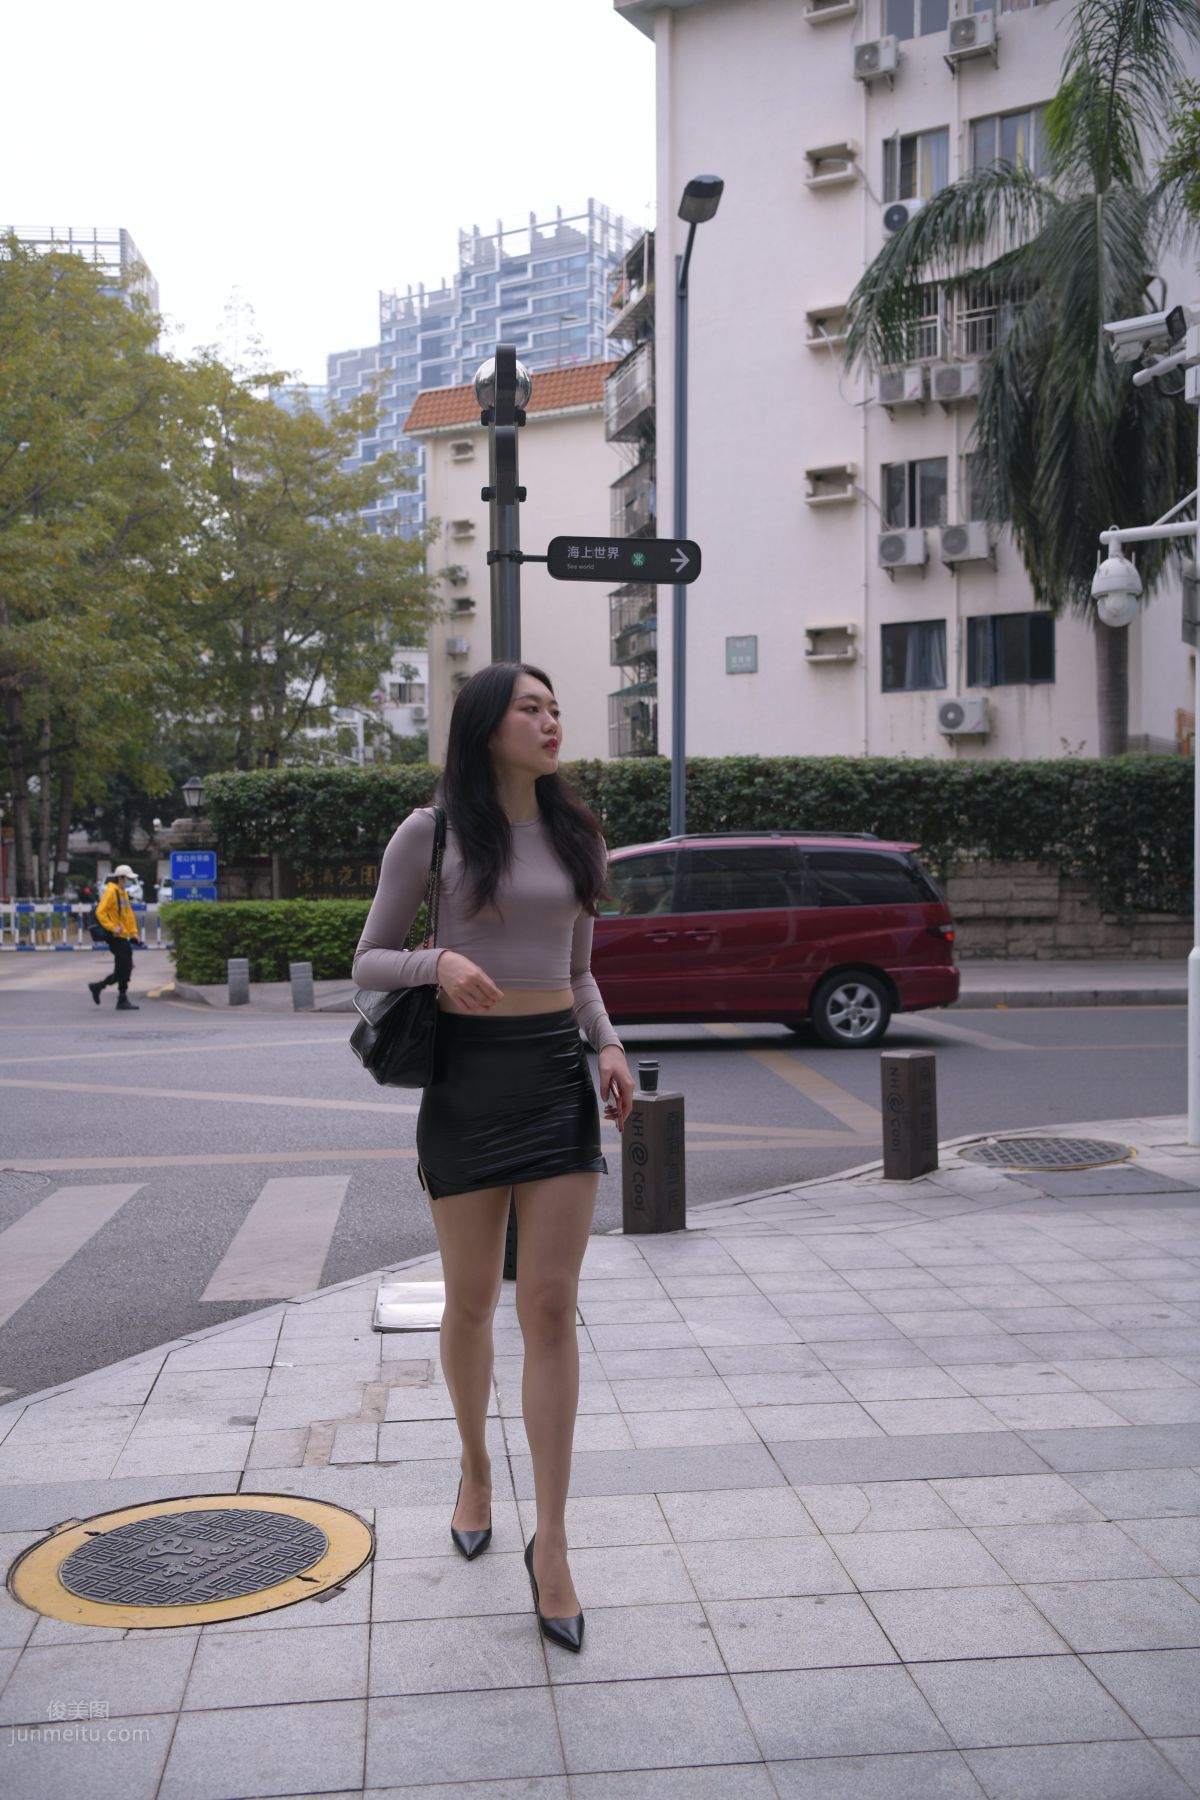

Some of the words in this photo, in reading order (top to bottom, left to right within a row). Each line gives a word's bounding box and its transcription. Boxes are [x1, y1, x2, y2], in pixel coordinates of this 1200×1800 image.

[567, 545, 620, 560] 海上世界
[190, 863, 196, 876] 1
